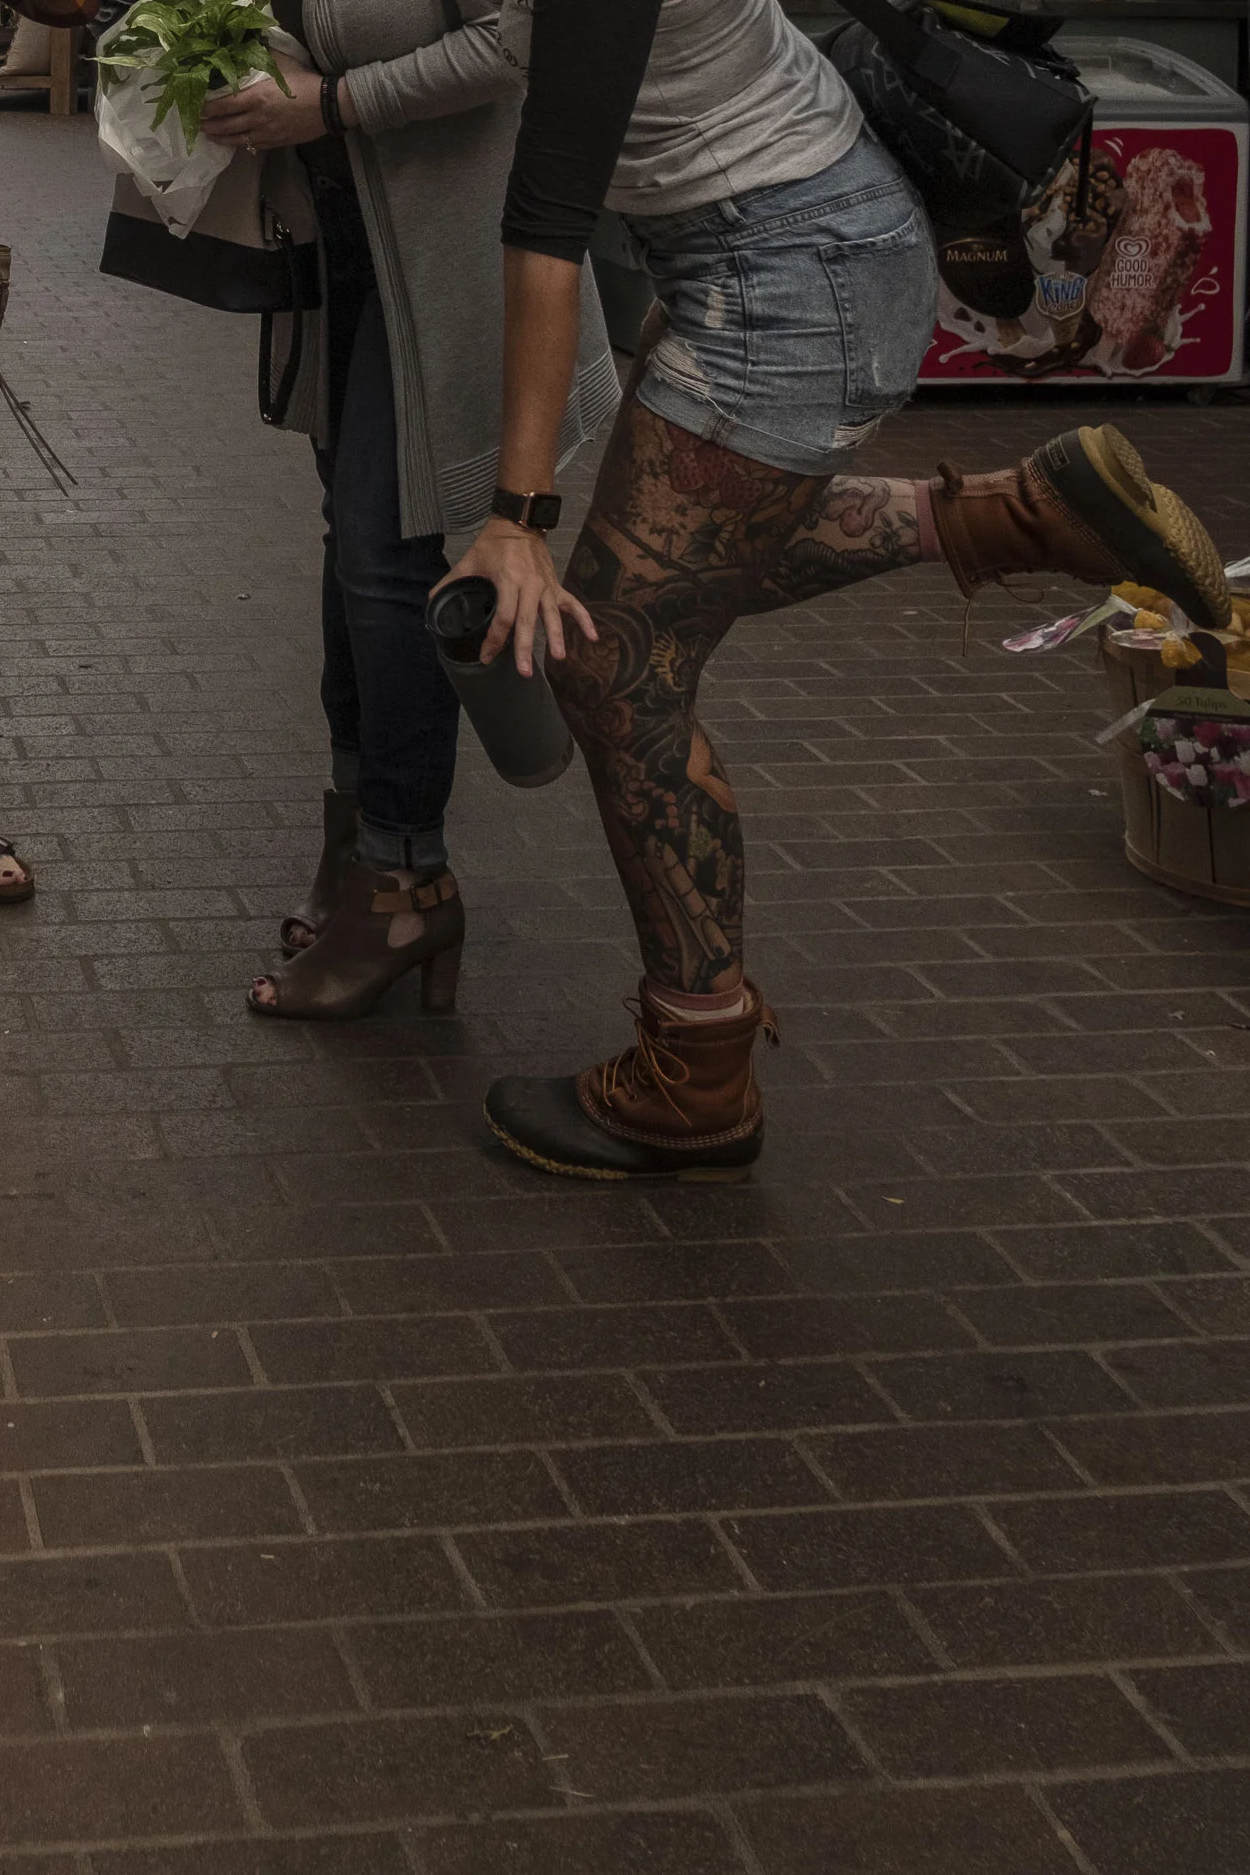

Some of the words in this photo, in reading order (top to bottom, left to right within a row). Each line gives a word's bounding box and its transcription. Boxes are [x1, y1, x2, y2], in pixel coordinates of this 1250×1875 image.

[945, 249, 1009, 263] MAGNUM
[1116, 259, 1148, 273] GOOD
[1195, 696, 1228, 711] Tulips
